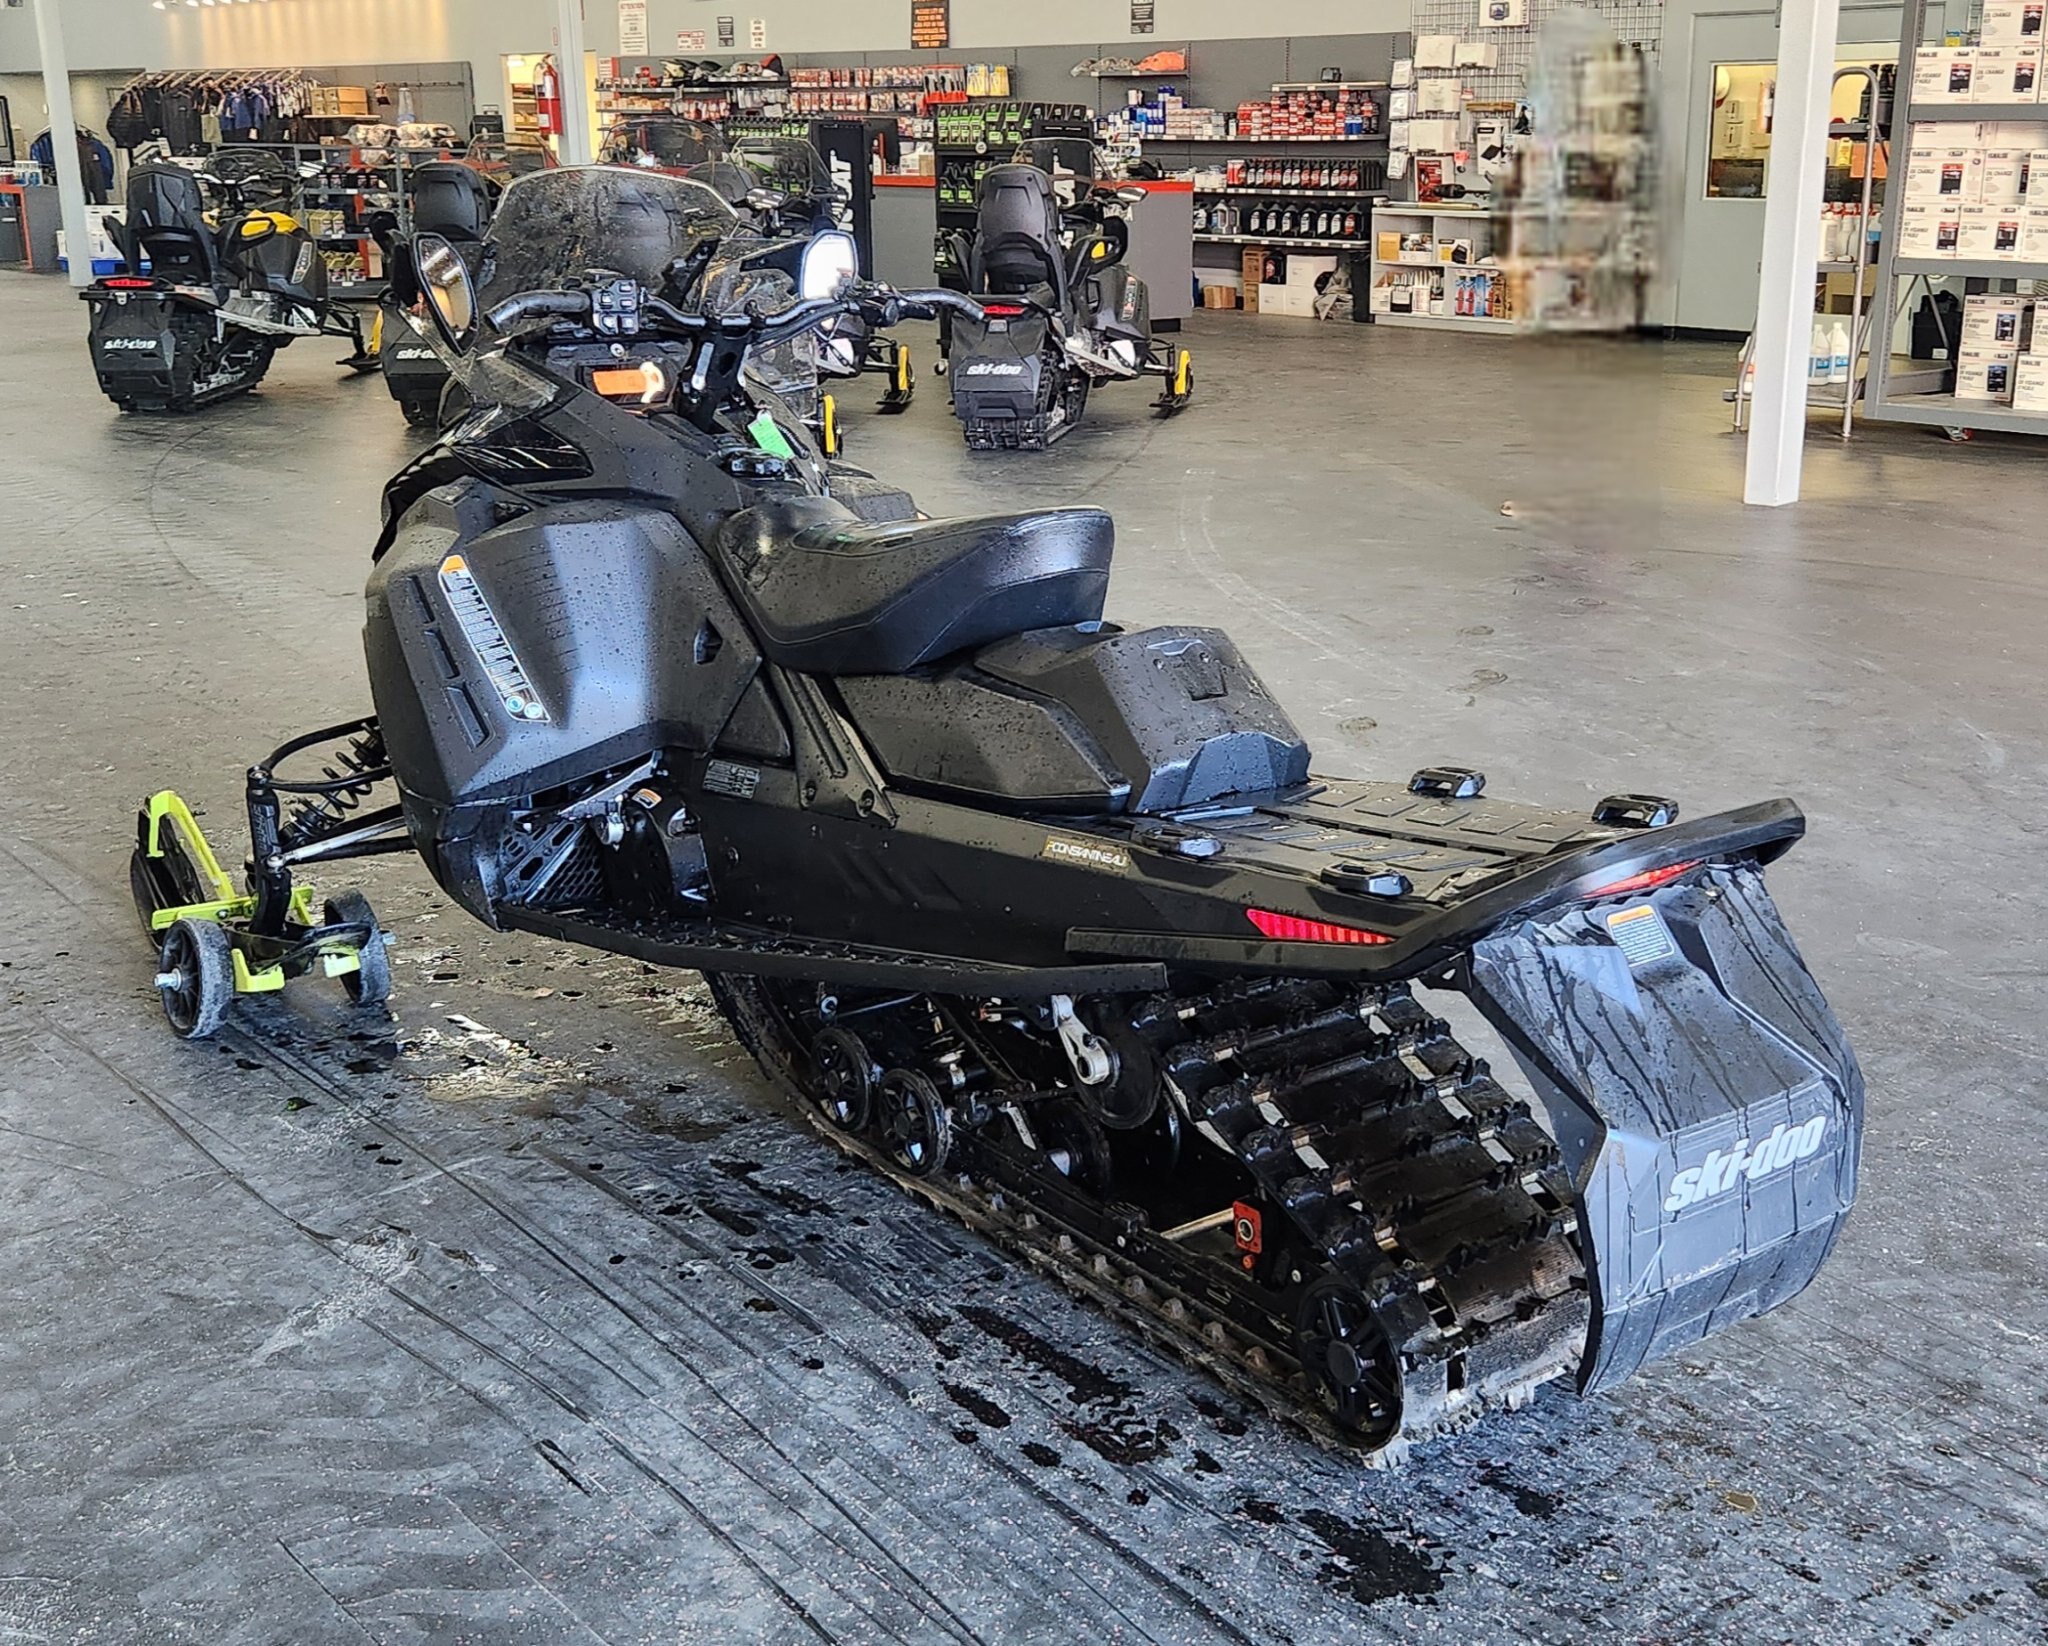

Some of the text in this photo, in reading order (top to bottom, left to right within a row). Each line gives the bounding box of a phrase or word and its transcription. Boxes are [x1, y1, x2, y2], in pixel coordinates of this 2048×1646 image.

[103, 338, 157, 350] ski-doo
[966, 363, 1022, 375] ski-doo
[1663, 1114, 1827, 1212] ski-doo
